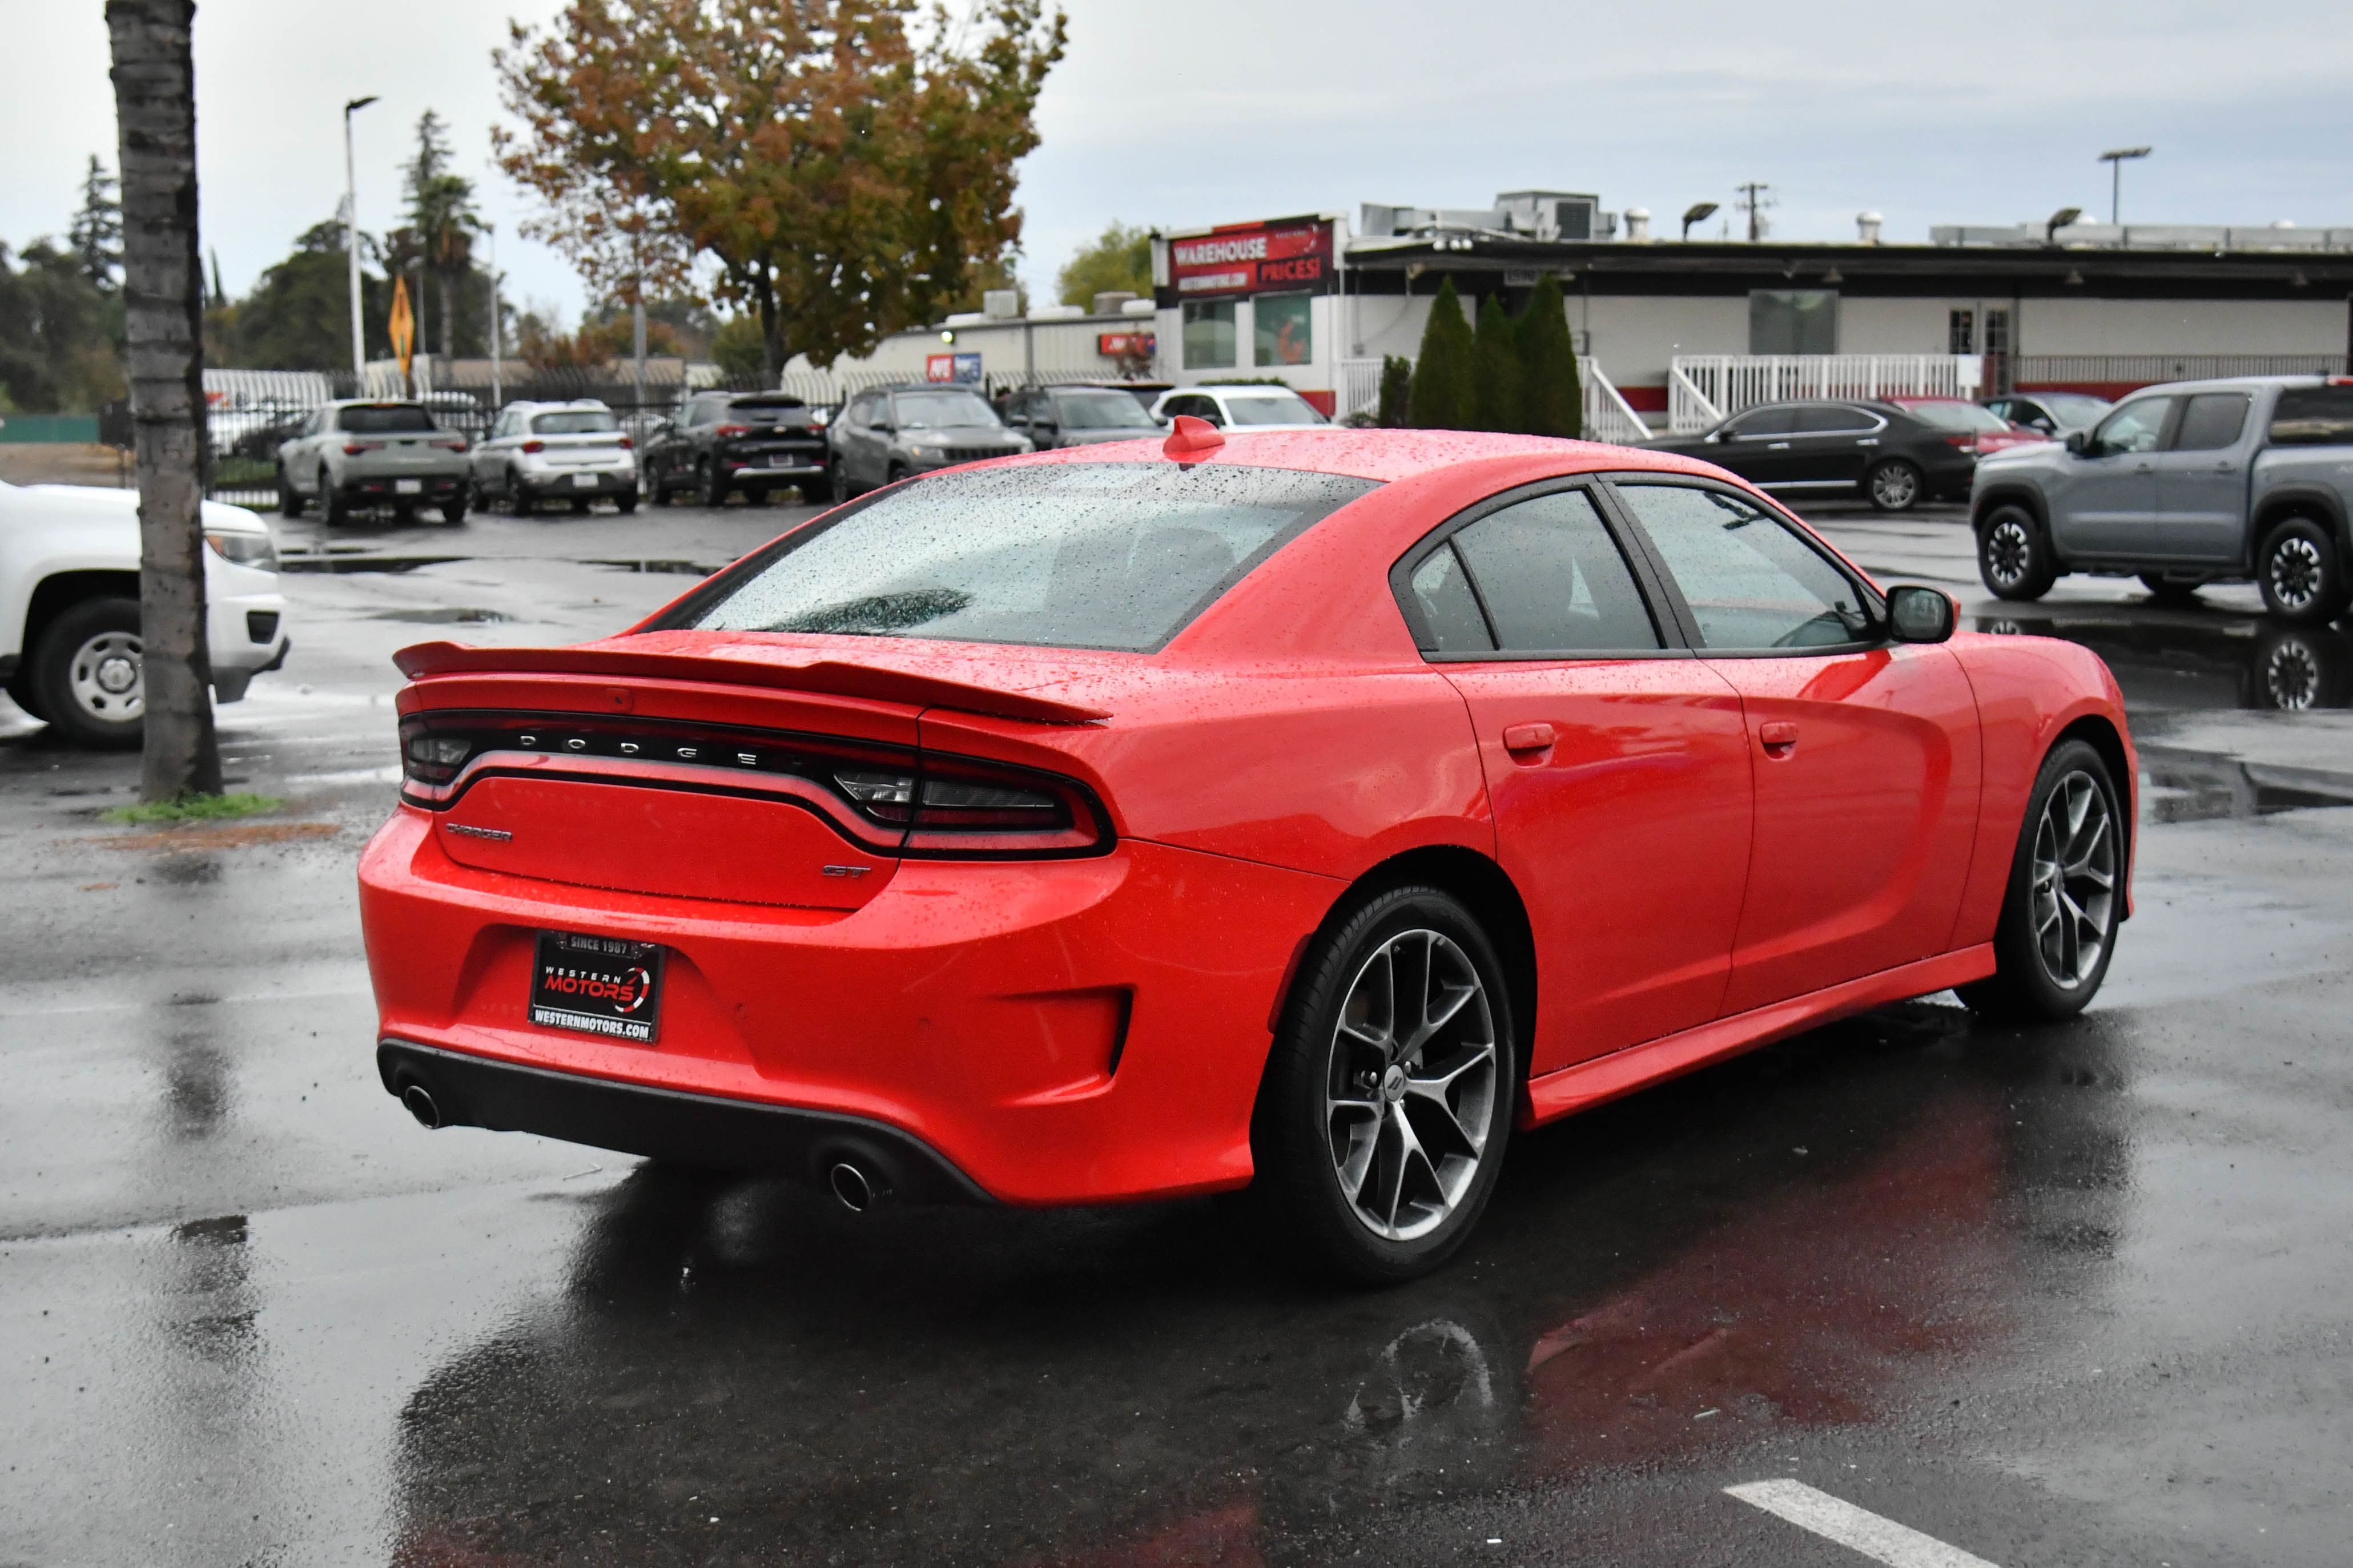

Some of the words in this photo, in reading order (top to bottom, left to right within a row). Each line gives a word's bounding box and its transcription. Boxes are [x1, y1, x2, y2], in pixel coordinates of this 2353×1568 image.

[1175, 236, 1267, 267] WAREHOUSE
[520, 735, 757, 765] DODGE
[446, 823, 513, 842] CHARGER
[823, 865, 871, 878] GT
[571, 936, 600, 951] SINCE
[603, 941, 628, 954] 1987
[545, 966, 621, 984] WESTERN
[544, 975, 635, 1002] MOTORS
[534, 1009, 650, 1039] WESTERNMOTORS.COM
